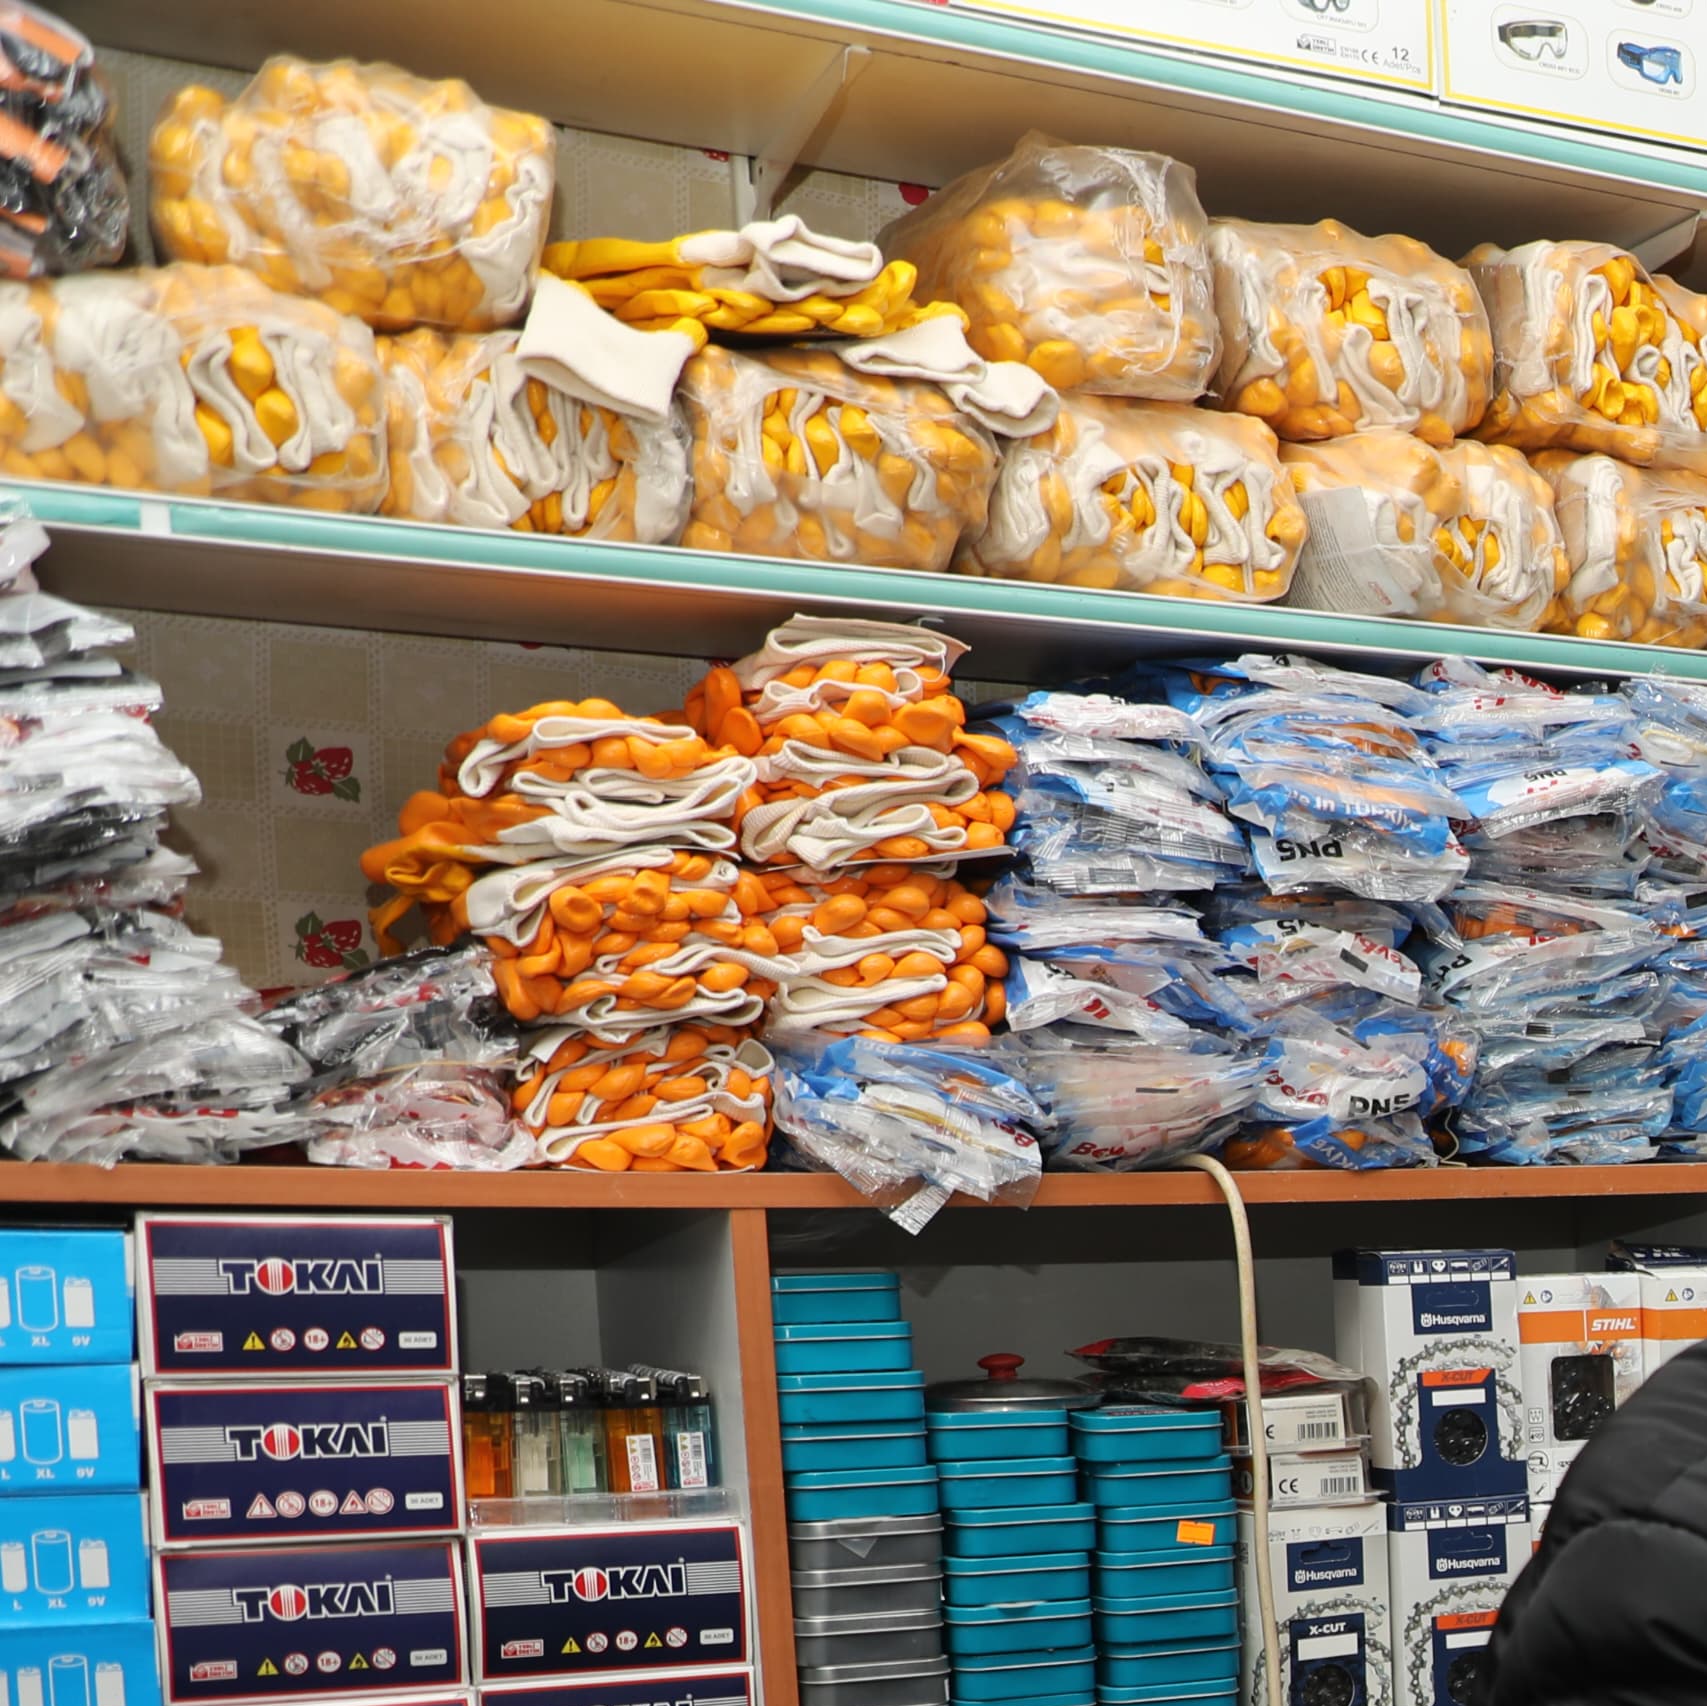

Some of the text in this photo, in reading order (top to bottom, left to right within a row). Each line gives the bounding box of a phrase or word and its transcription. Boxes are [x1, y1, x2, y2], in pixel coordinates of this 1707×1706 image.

[218, 1257, 384, 1295] TOKAI
[1433, 1312, 1486, 1328] Husqvarna
[1591, 1317, 1636, 1332] STIHL
[225, 1421, 390, 1462] TOKAI
[1447, 1557, 1500, 1574] Husqvarna
[541, 1561, 687, 1605] TOKAI
[1307, 1567, 1357, 1584] Husqvarna
[233, 1581, 396, 1623] TOKAI
[1309, 1623, 1346, 1636] X-CUT
